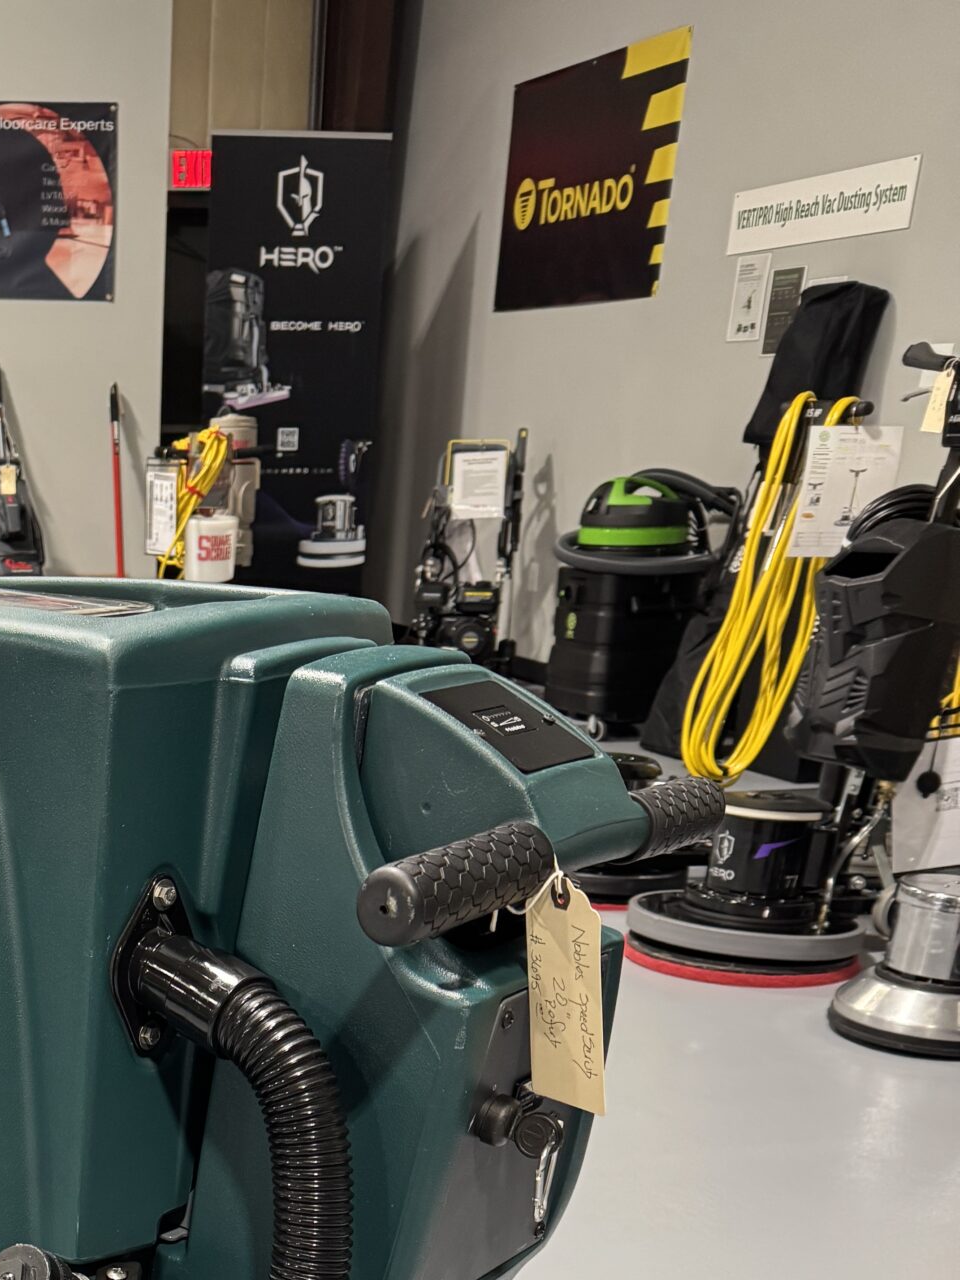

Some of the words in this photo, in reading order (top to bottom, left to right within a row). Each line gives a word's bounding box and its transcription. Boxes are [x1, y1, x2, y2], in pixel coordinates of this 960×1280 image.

[60, 117, 115, 133] Experts
[538, 173, 634, 225] TORNADO
[737, 205, 774, 230] VERTIPRO
[775, 201, 794, 228] High
[794, 194, 820, 220] Reach
[820, 193, 836, 215] Vac
[838, 187, 872, 214] Dusting
[872, 184, 908, 212] System
[270, 321, 322, 331] BECOME
[328, 321, 362, 333] HERO
[571, 924, 590, 981] Nobles
